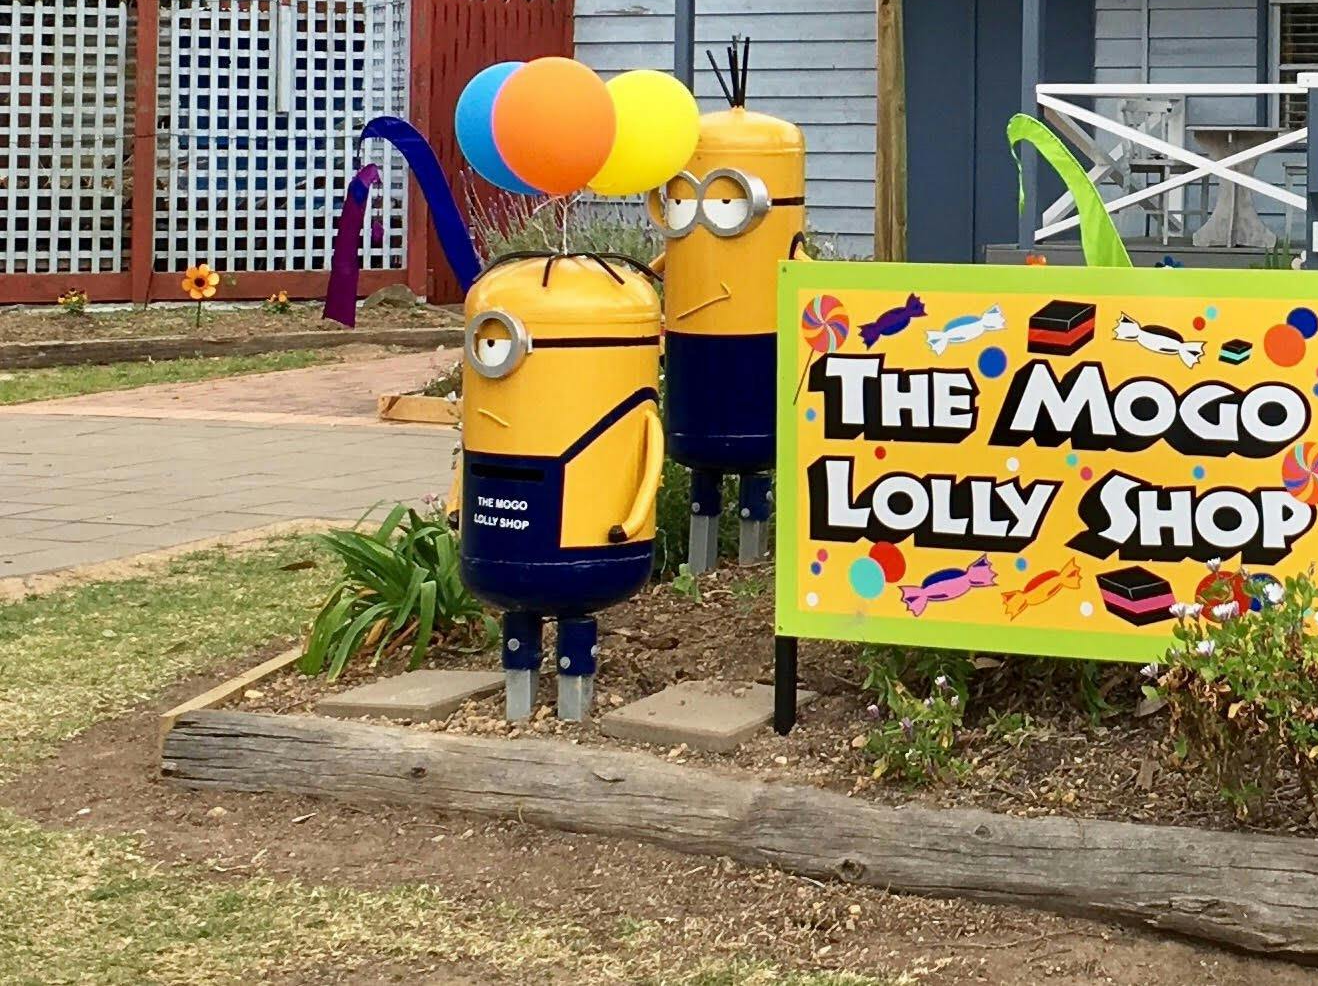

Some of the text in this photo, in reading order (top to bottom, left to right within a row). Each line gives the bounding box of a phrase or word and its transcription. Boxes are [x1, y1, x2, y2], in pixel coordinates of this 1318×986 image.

[815, 355, 1308, 451] THE MOGO
[474, 513, 530, 531] LOLLY SHOP
[477, 496, 528, 511] THE MOGO
[816, 458, 1315, 556] LOLLY SHOP
